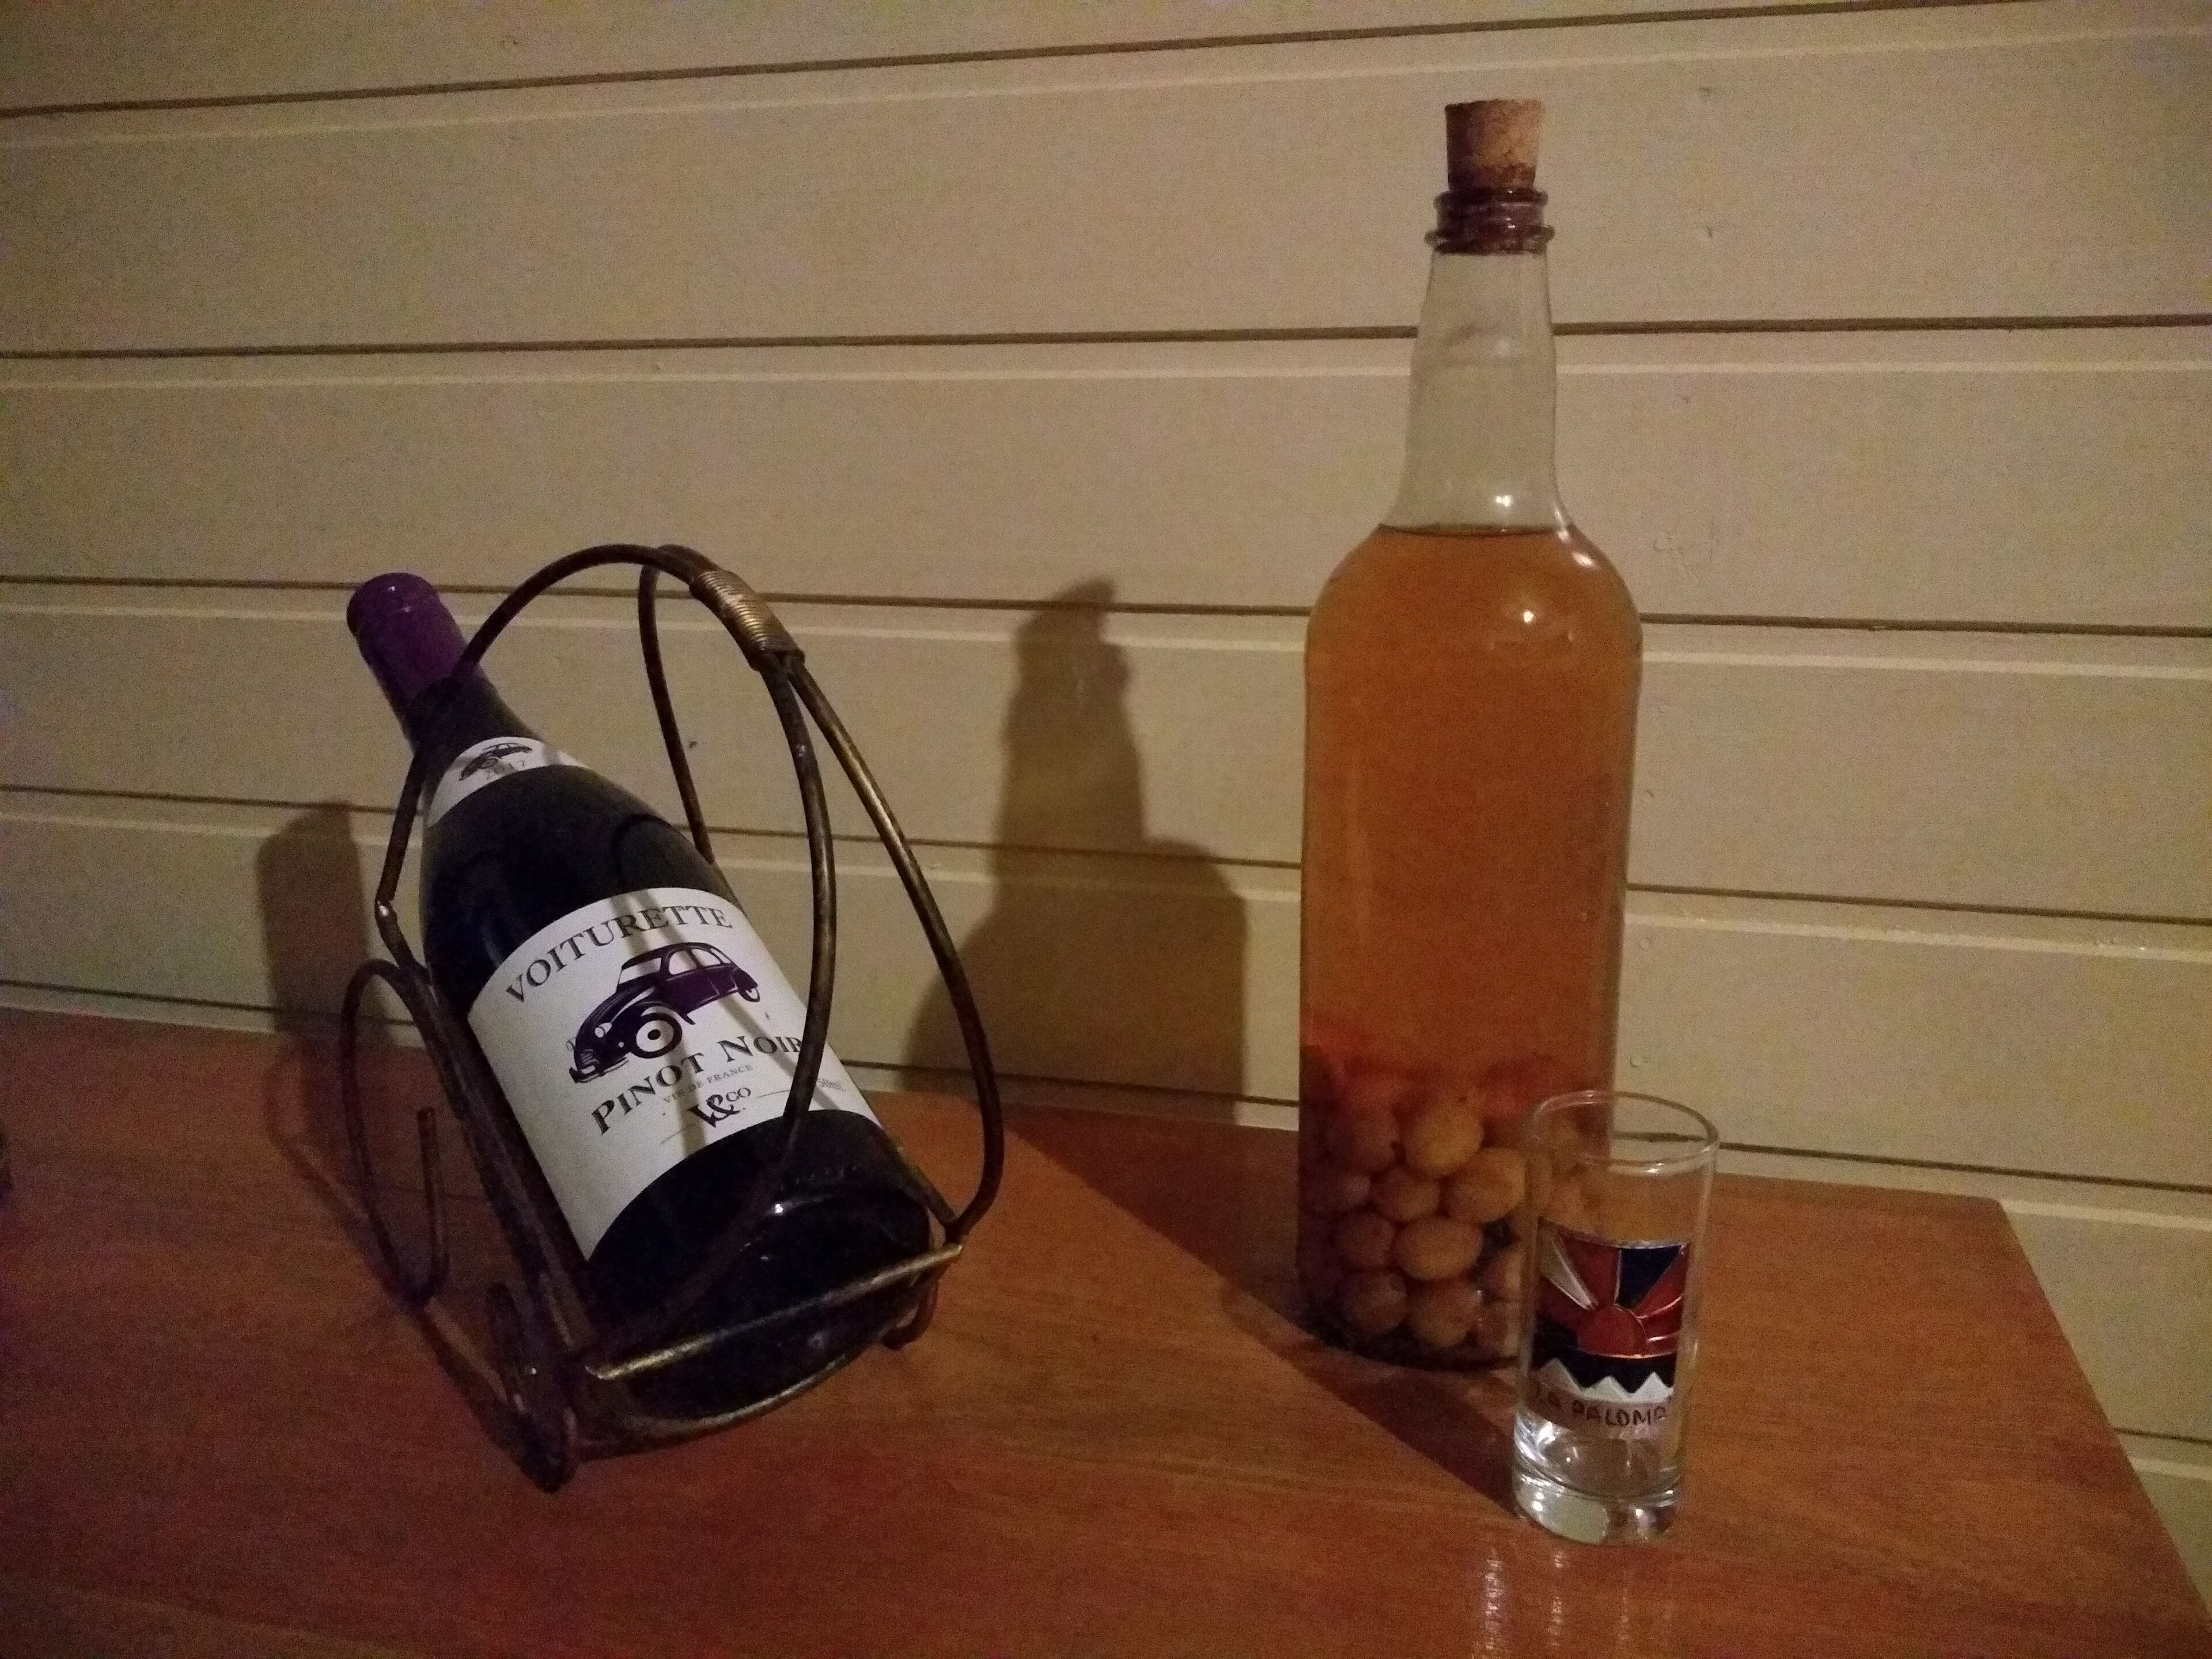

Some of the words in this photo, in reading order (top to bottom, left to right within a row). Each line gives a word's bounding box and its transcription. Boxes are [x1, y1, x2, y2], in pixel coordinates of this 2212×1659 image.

[506, 905, 733, 1003] VOITURETTE
[590, 1052, 704, 1135] PINOT
[706, 1064, 753, 1084] FRANCE
